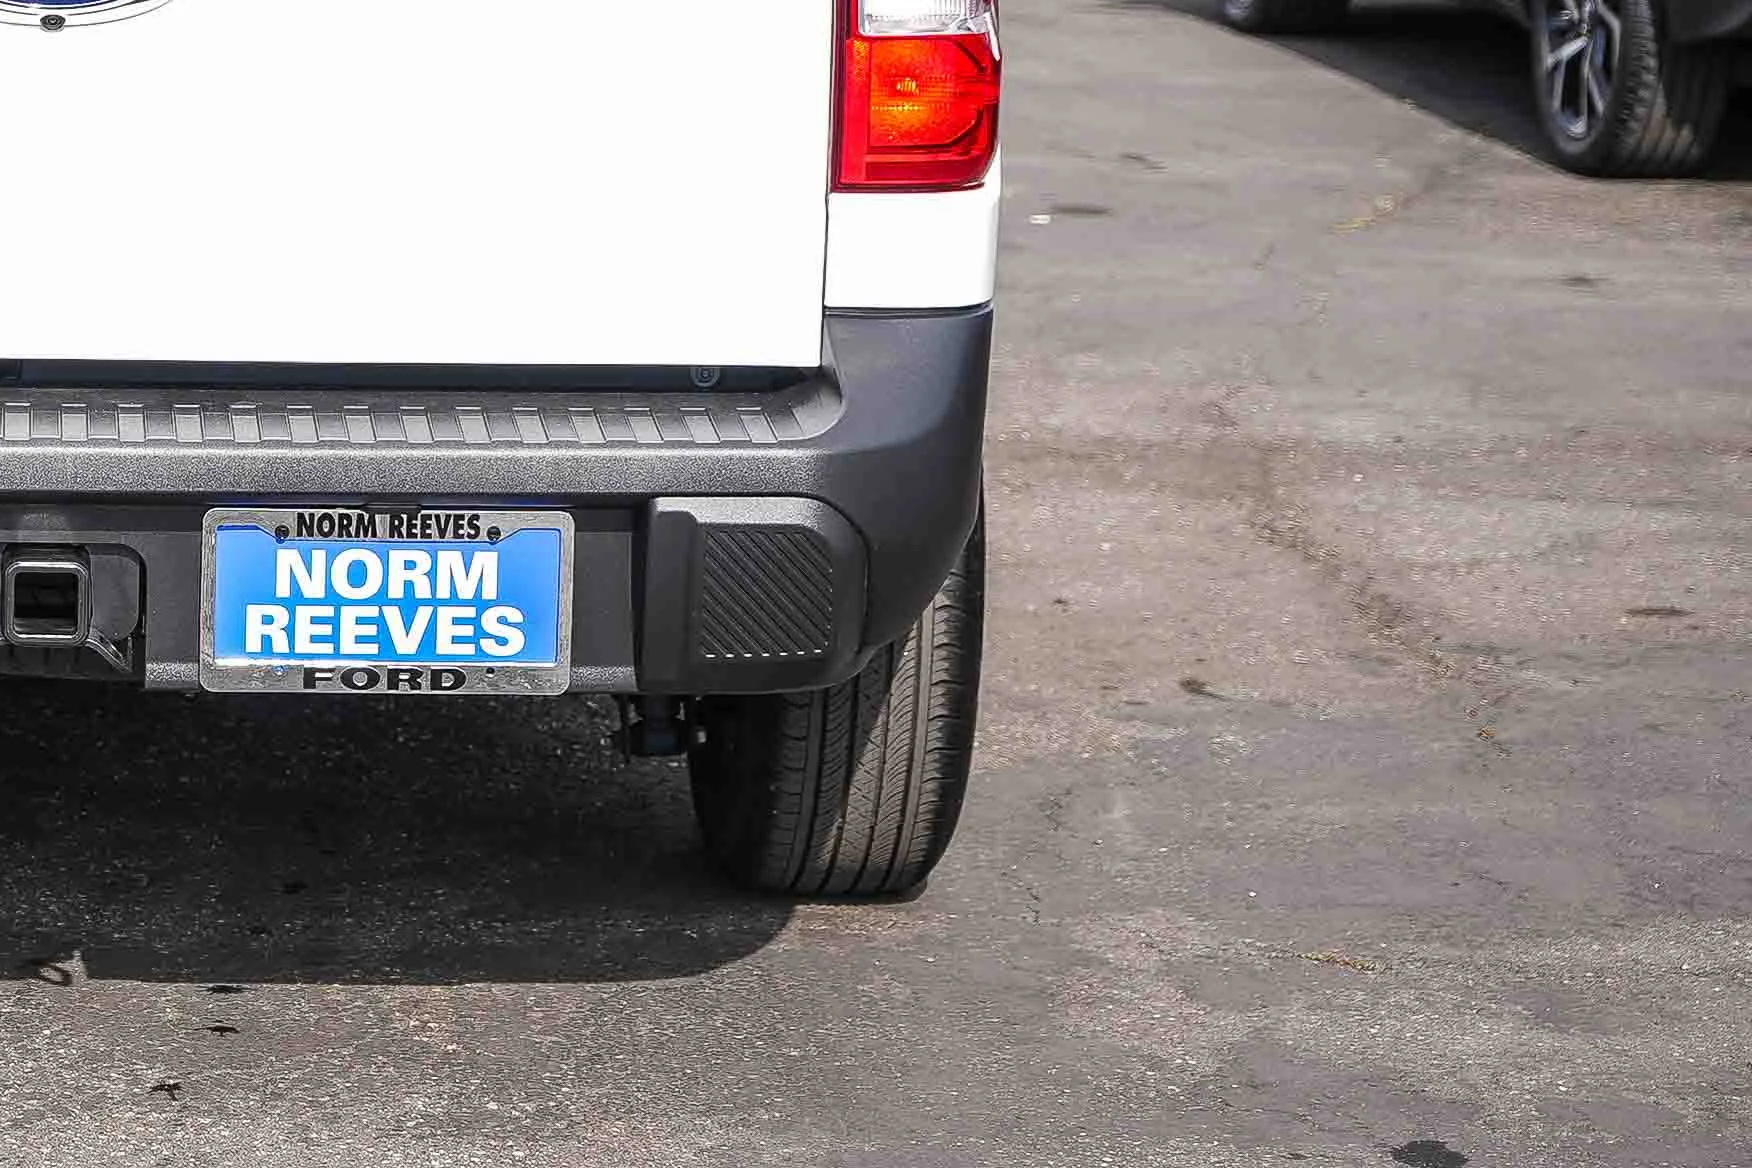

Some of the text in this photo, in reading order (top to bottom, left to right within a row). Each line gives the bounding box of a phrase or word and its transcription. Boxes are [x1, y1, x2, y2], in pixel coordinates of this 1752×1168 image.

[296, 513, 481, 540] NORM REEVES
[275, 548, 499, 601] NORM
[245, 604, 526, 658] REEVES
[303, 667, 467, 692] FORD
